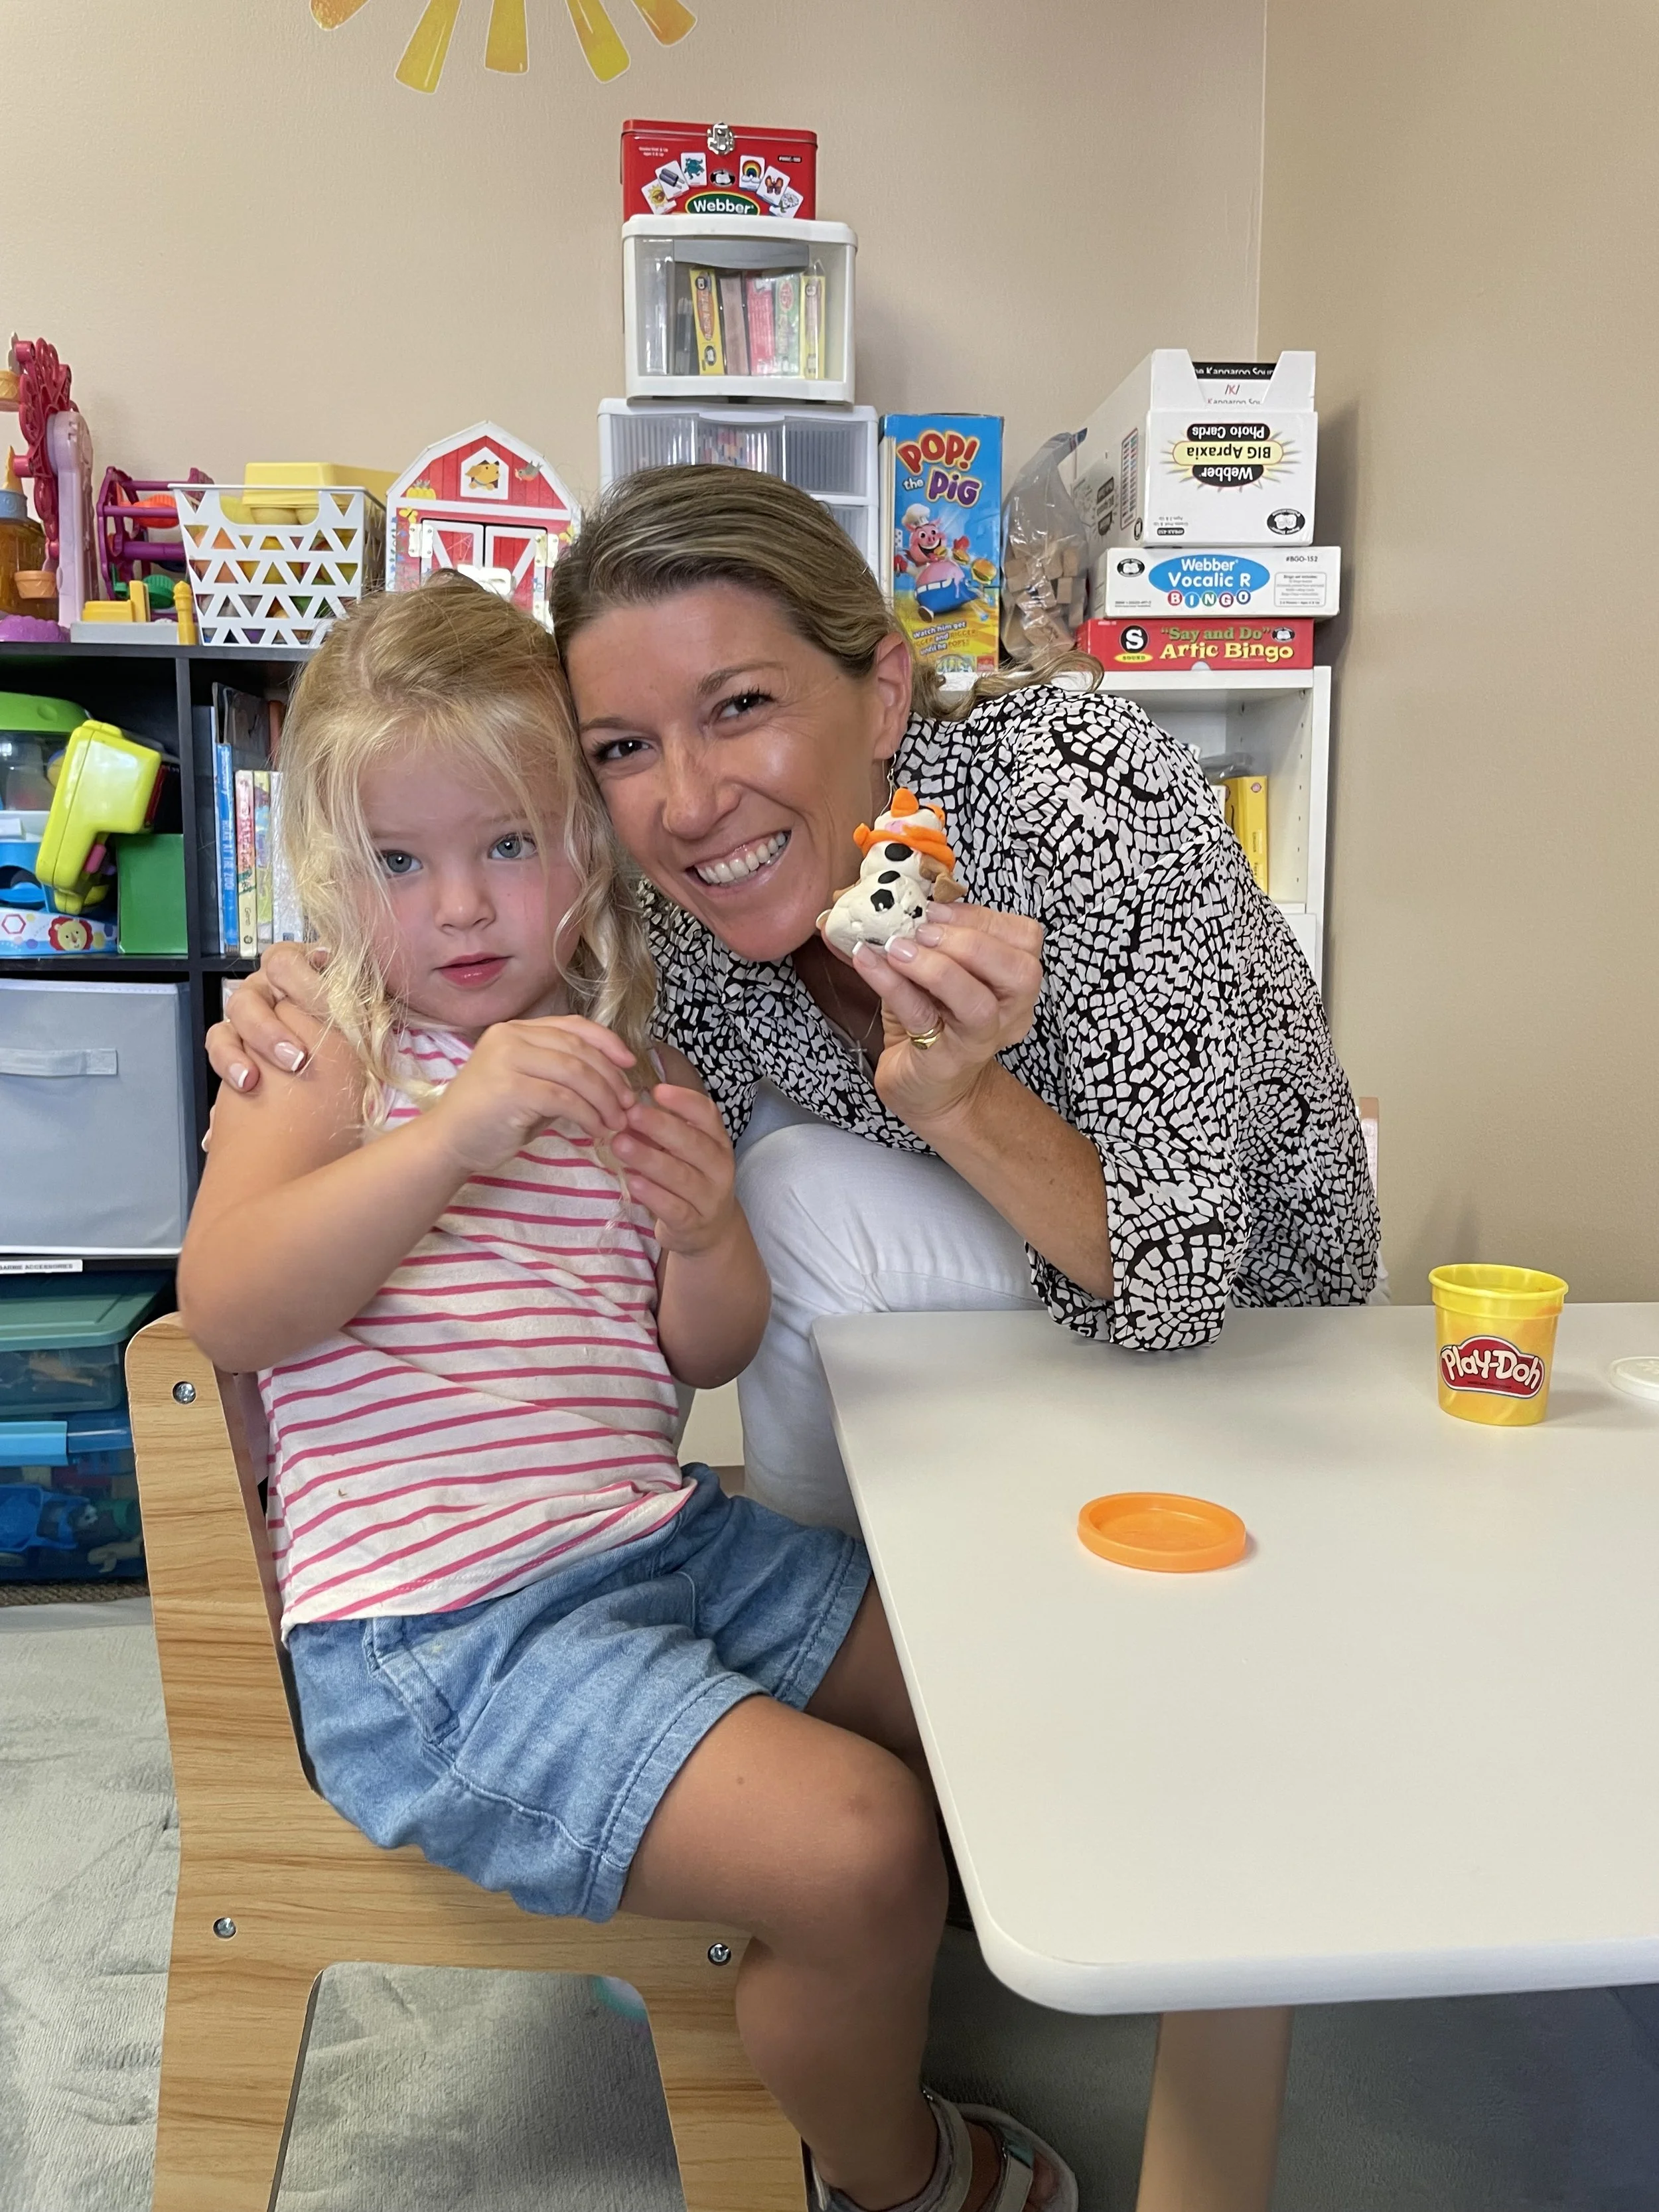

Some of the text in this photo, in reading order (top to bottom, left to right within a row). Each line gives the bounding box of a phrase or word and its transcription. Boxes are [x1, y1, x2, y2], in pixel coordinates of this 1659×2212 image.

[693, 199, 751, 214] Webber
[1191, 425, 1265, 439] Photo Cards
[898, 431, 979, 475] POP!
[1187, 443, 1271, 459] BIG Apraxia
[1200, 467, 1253, 482] Webber
[903, 477, 924, 491] the
[1181, 558, 1234, 571] Webber
[1168, 571, 1251, 588] Vocalic R
[1169, 590, 1250, 607] BINGO
[914, 621, 966, 638] Watch him get
[935, 632, 949, 642] and
[1204, 627, 1234, 639] and
[1126, 629, 1144, 650] S
[1159, 641, 1294, 663] Artic Bingo
[1441, 1345, 1542, 1390] Play-Doh
